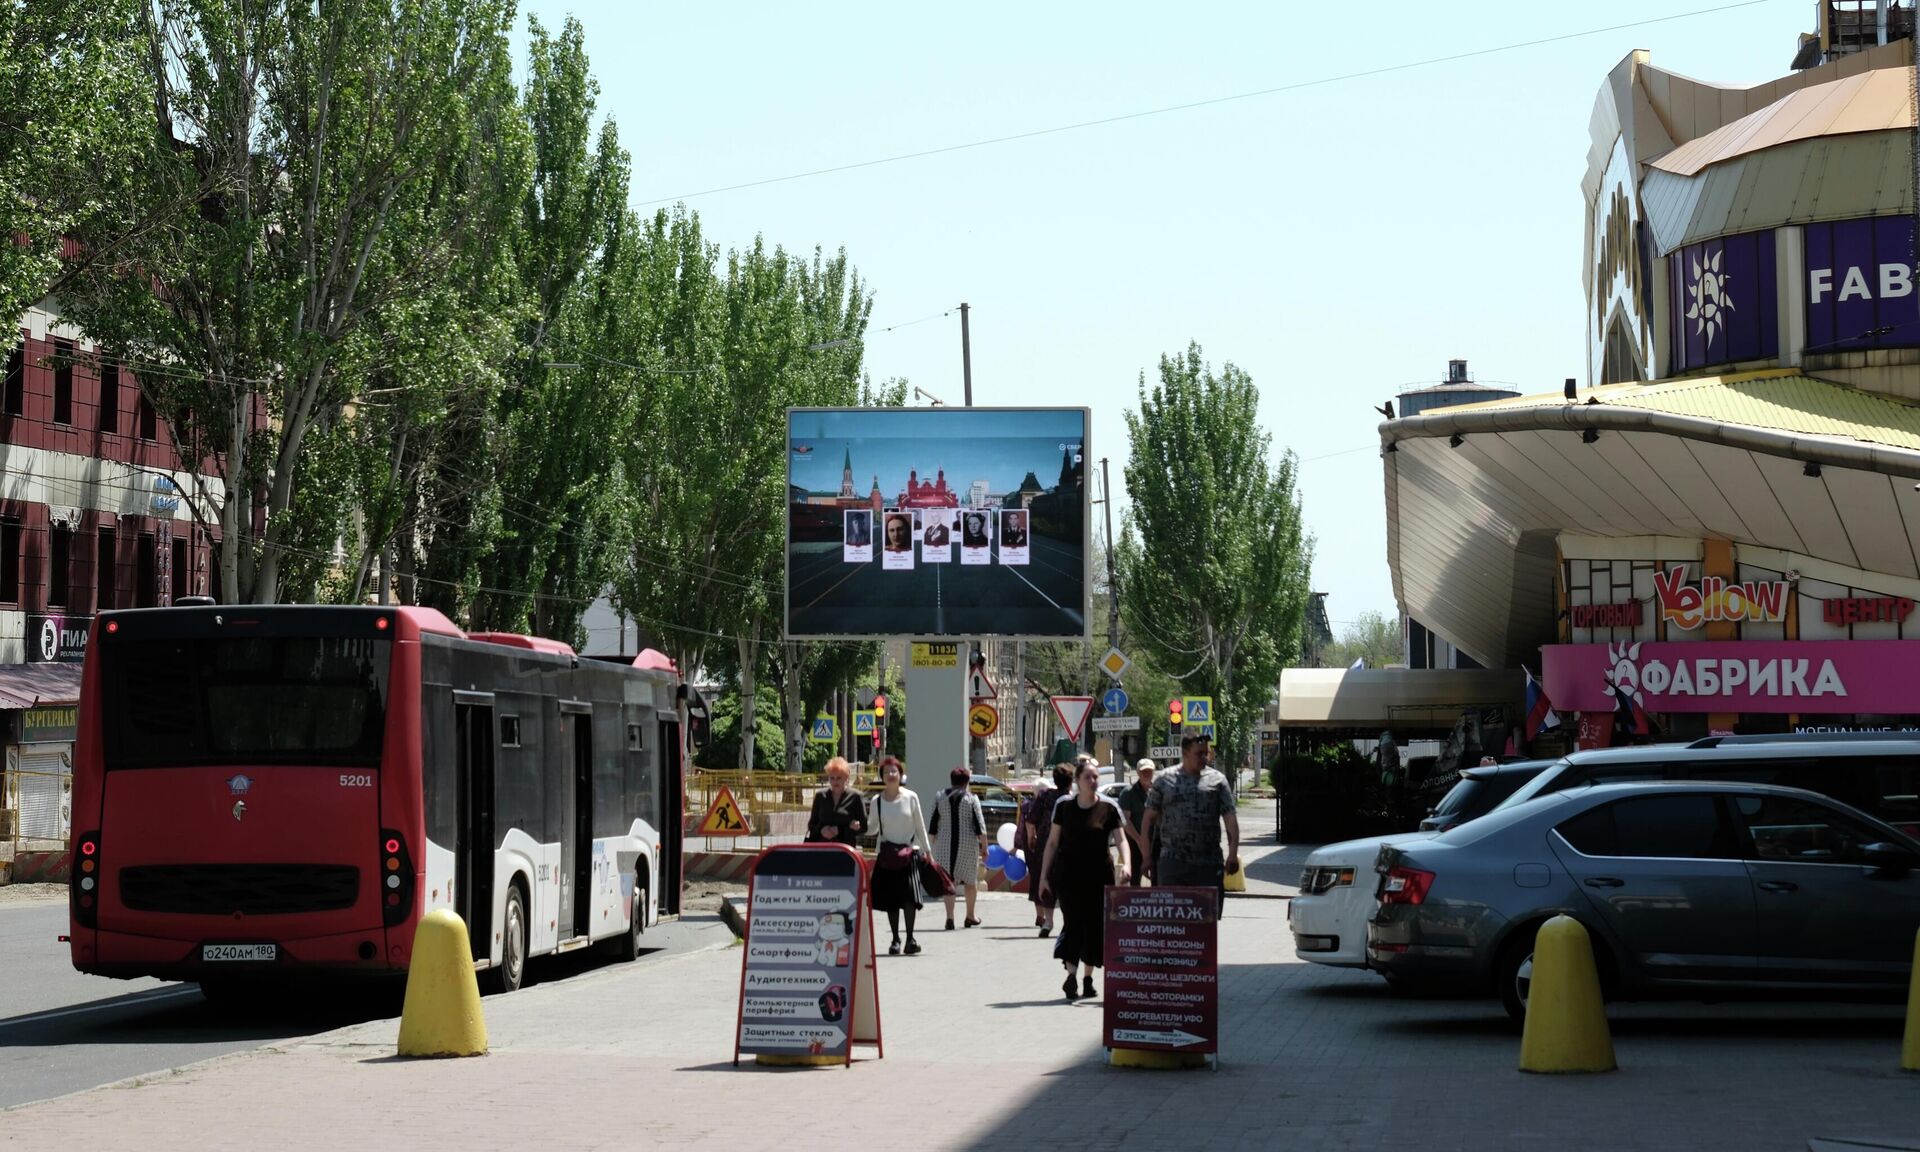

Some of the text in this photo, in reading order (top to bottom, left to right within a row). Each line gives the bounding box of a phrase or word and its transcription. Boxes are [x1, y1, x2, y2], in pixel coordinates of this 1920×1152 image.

[1810, 263, 1913, 304] FAB
[1571, 598, 1643, 628] ТОРГОВЫЙ
[1822, 597, 1916, 627] ЦЕНТР
[1641, 659, 1848, 697] ФАБРИКА
[1152, 748, 1180, 757] СТОП
[339, 775, 373, 787] 5201
[754, 894, 841, 905] Гаджеты Xiaomi
[1118, 905, 1203, 920] ЭРМИТАЖ
[752, 918, 815, 929] Аксессуары
[1136, 925, 1186, 936] КАРТИНЫ
[1118, 939, 1205, 950] ПЛЕТЕНЫЕ КОКОНЫ
[206, 945, 273, 959] О240АМ 180
[750, 947, 813, 959] Смартфоны
[1124, 955, 1151, 964] ОПТОМ
[1163, 957, 1199, 967] РОЗНИЦУ
[748, 974, 827, 987] Аудиотехника
[1106, 970, 1216, 983] РАСКЛАДУШКИ, ШЕЗЛОНГИ
[1117, 990, 1205, 1002] ИКОНЫ, ФОТОРАМКИ
[746, 999, 815, 1008] Компьютерная
[745, 1007, 796, 1016] периферия
[1117, 1011, 1203, 1024] ОБОГРЕВАТЕЛИ УФО
[744, 1027, 834, 1038] Защитные стекла
[1116, 1030, 1122, 1039] 2
